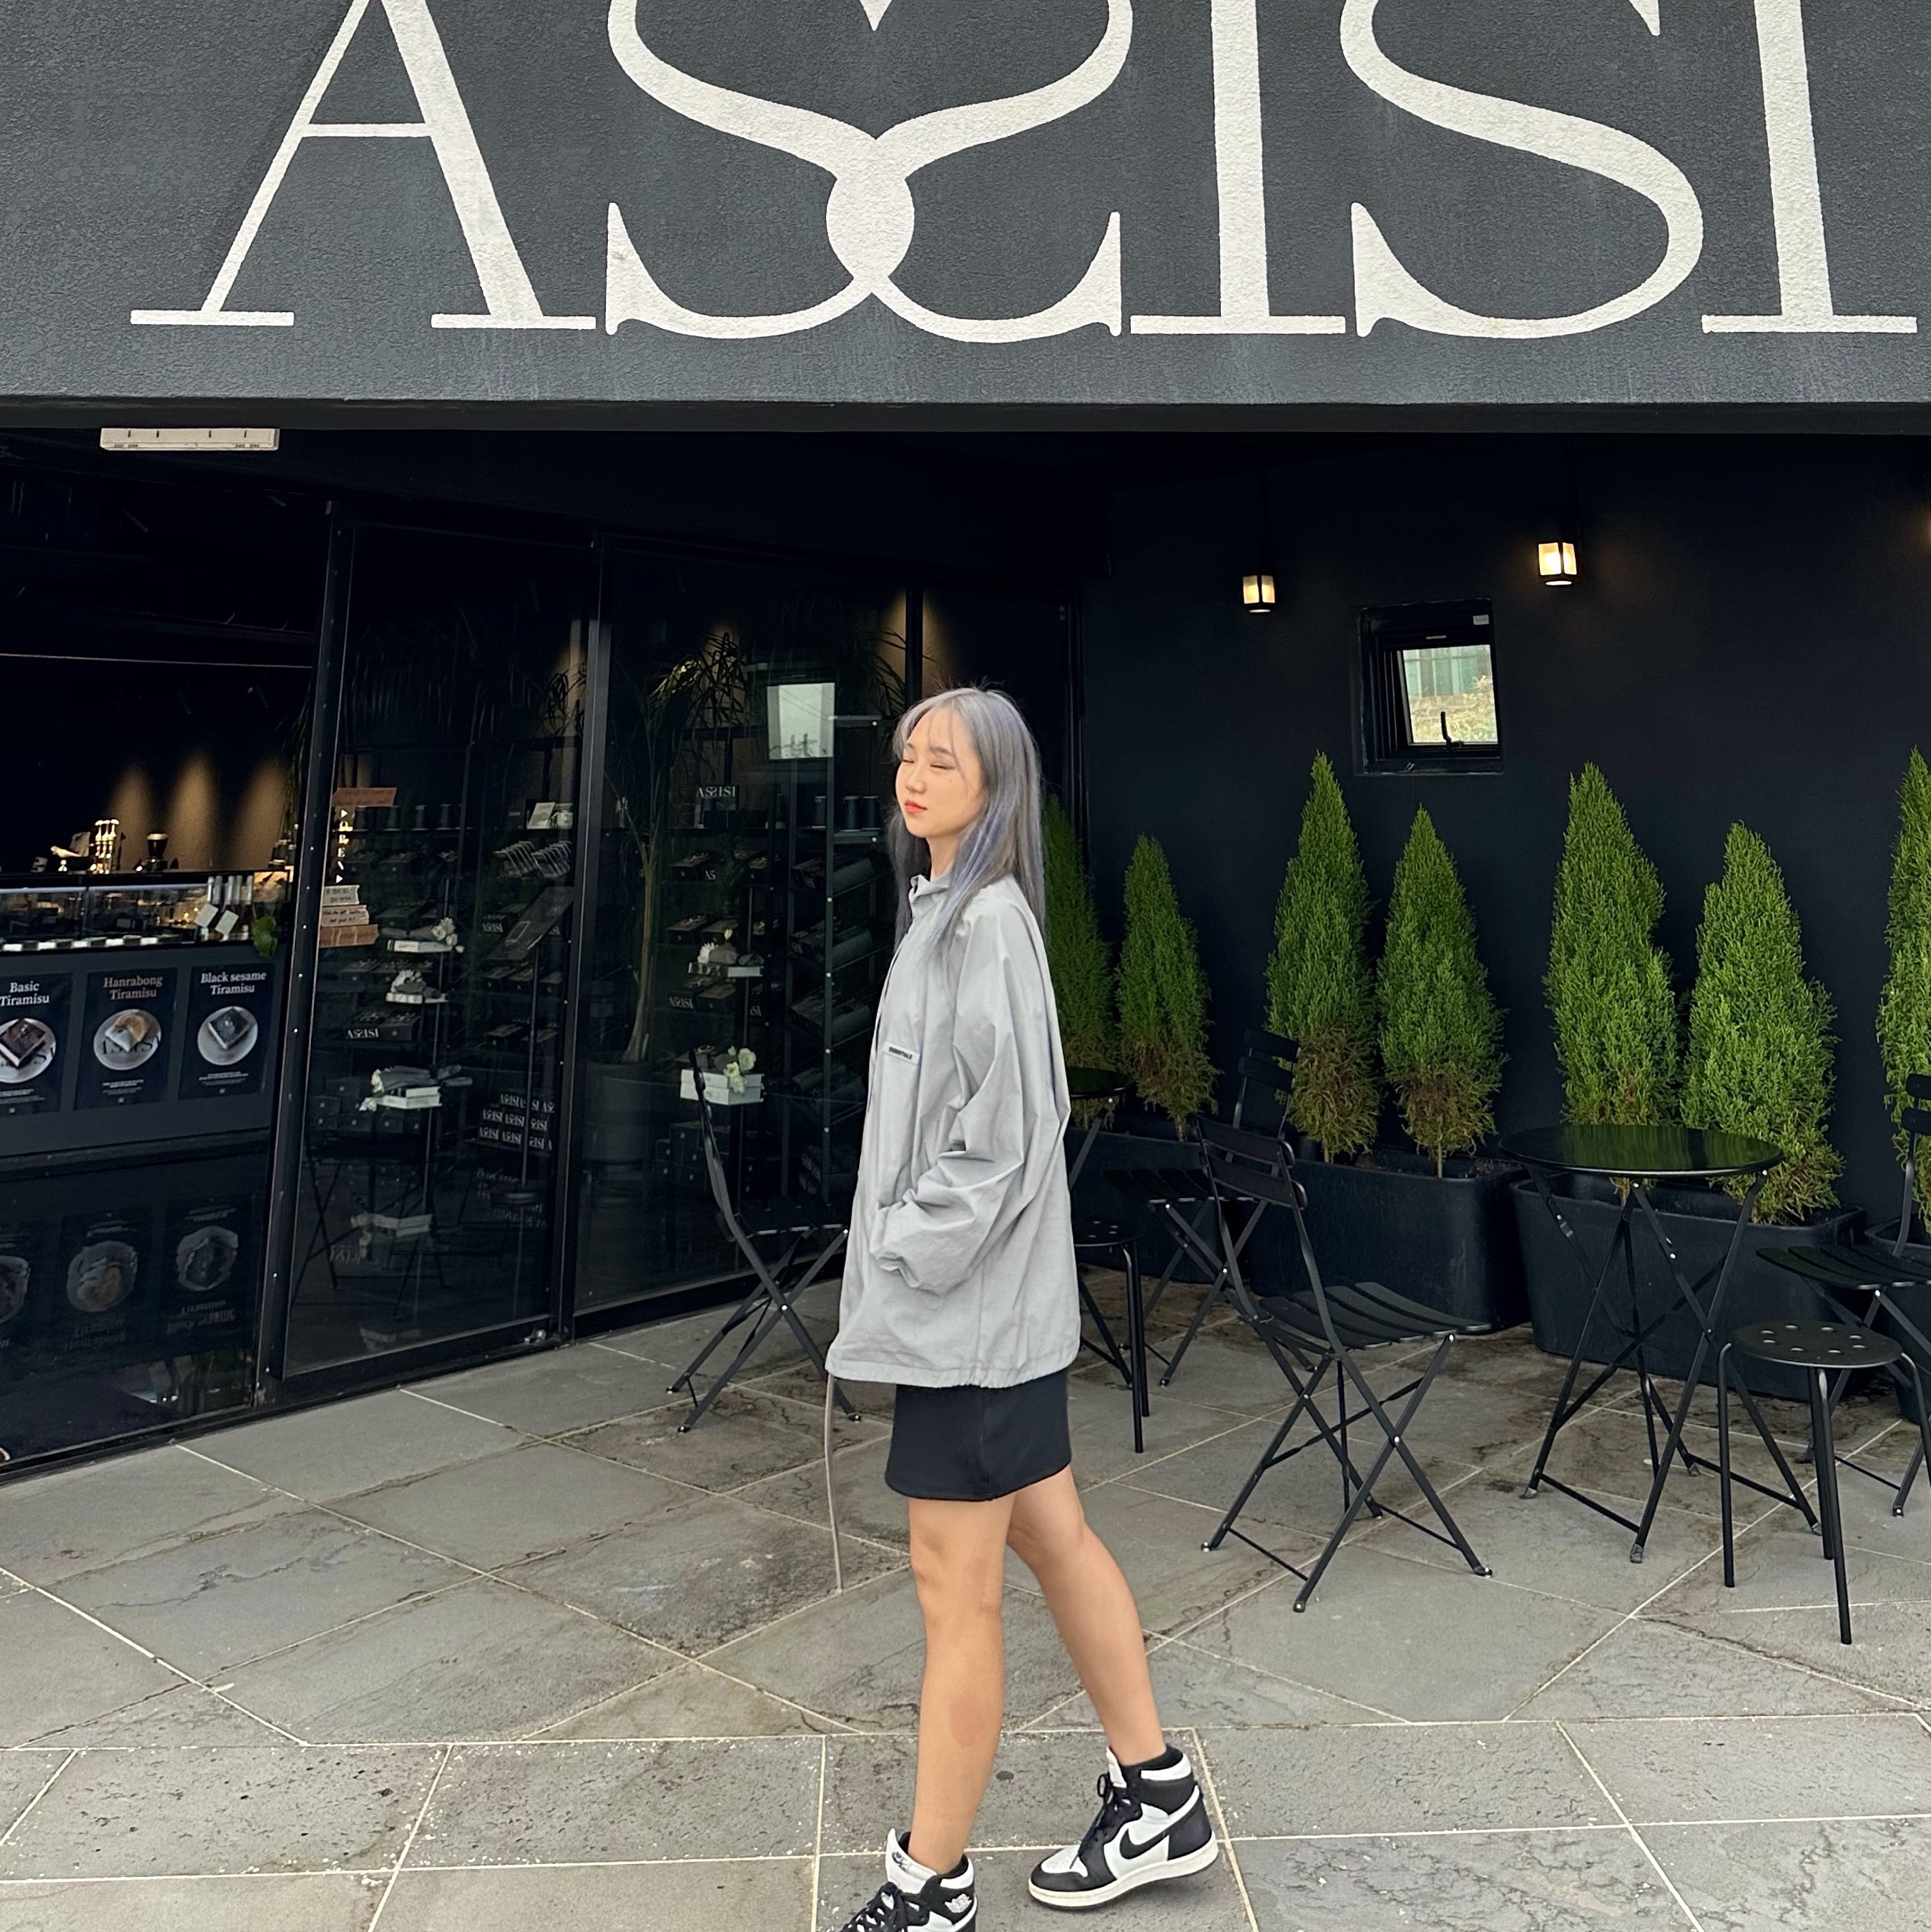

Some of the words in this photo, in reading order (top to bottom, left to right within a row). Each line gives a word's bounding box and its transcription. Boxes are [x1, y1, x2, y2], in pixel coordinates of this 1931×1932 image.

[103, 975, 163, 988] Hanrabong
[200, 971, 229, 984] Black
[230, 972, 267, 982] sesame
[9, 980, 40, 993] Basic
[210, 983, 255, 995] Tiramisu
[0, 993, 50, 1006] Tiramisu
[109, 987, 157, 1000] Tiramisu
